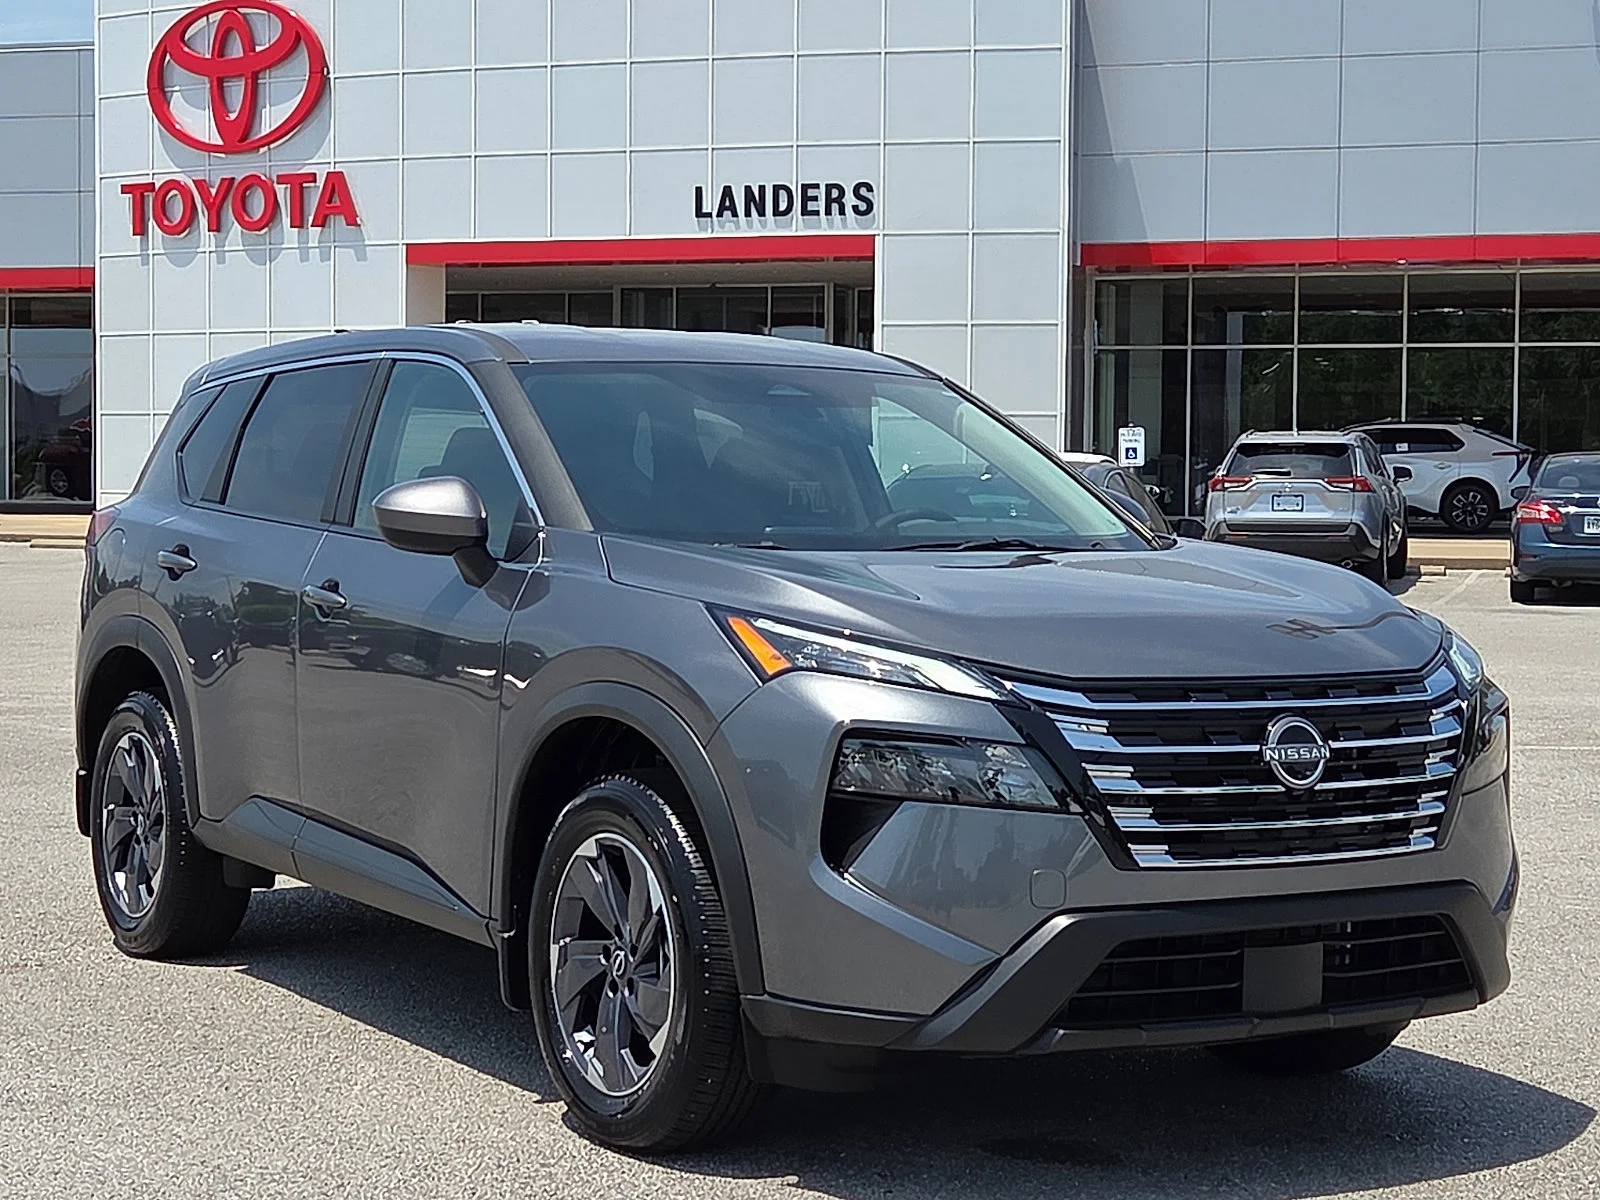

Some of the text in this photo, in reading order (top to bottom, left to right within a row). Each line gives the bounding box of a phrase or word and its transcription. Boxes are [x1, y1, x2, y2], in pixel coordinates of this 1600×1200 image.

[120, 170, 361, 237] TOYOTA
[694, 181, 875, 219] LANDERS
[1265, 745, 1330, 761] NISSAN
